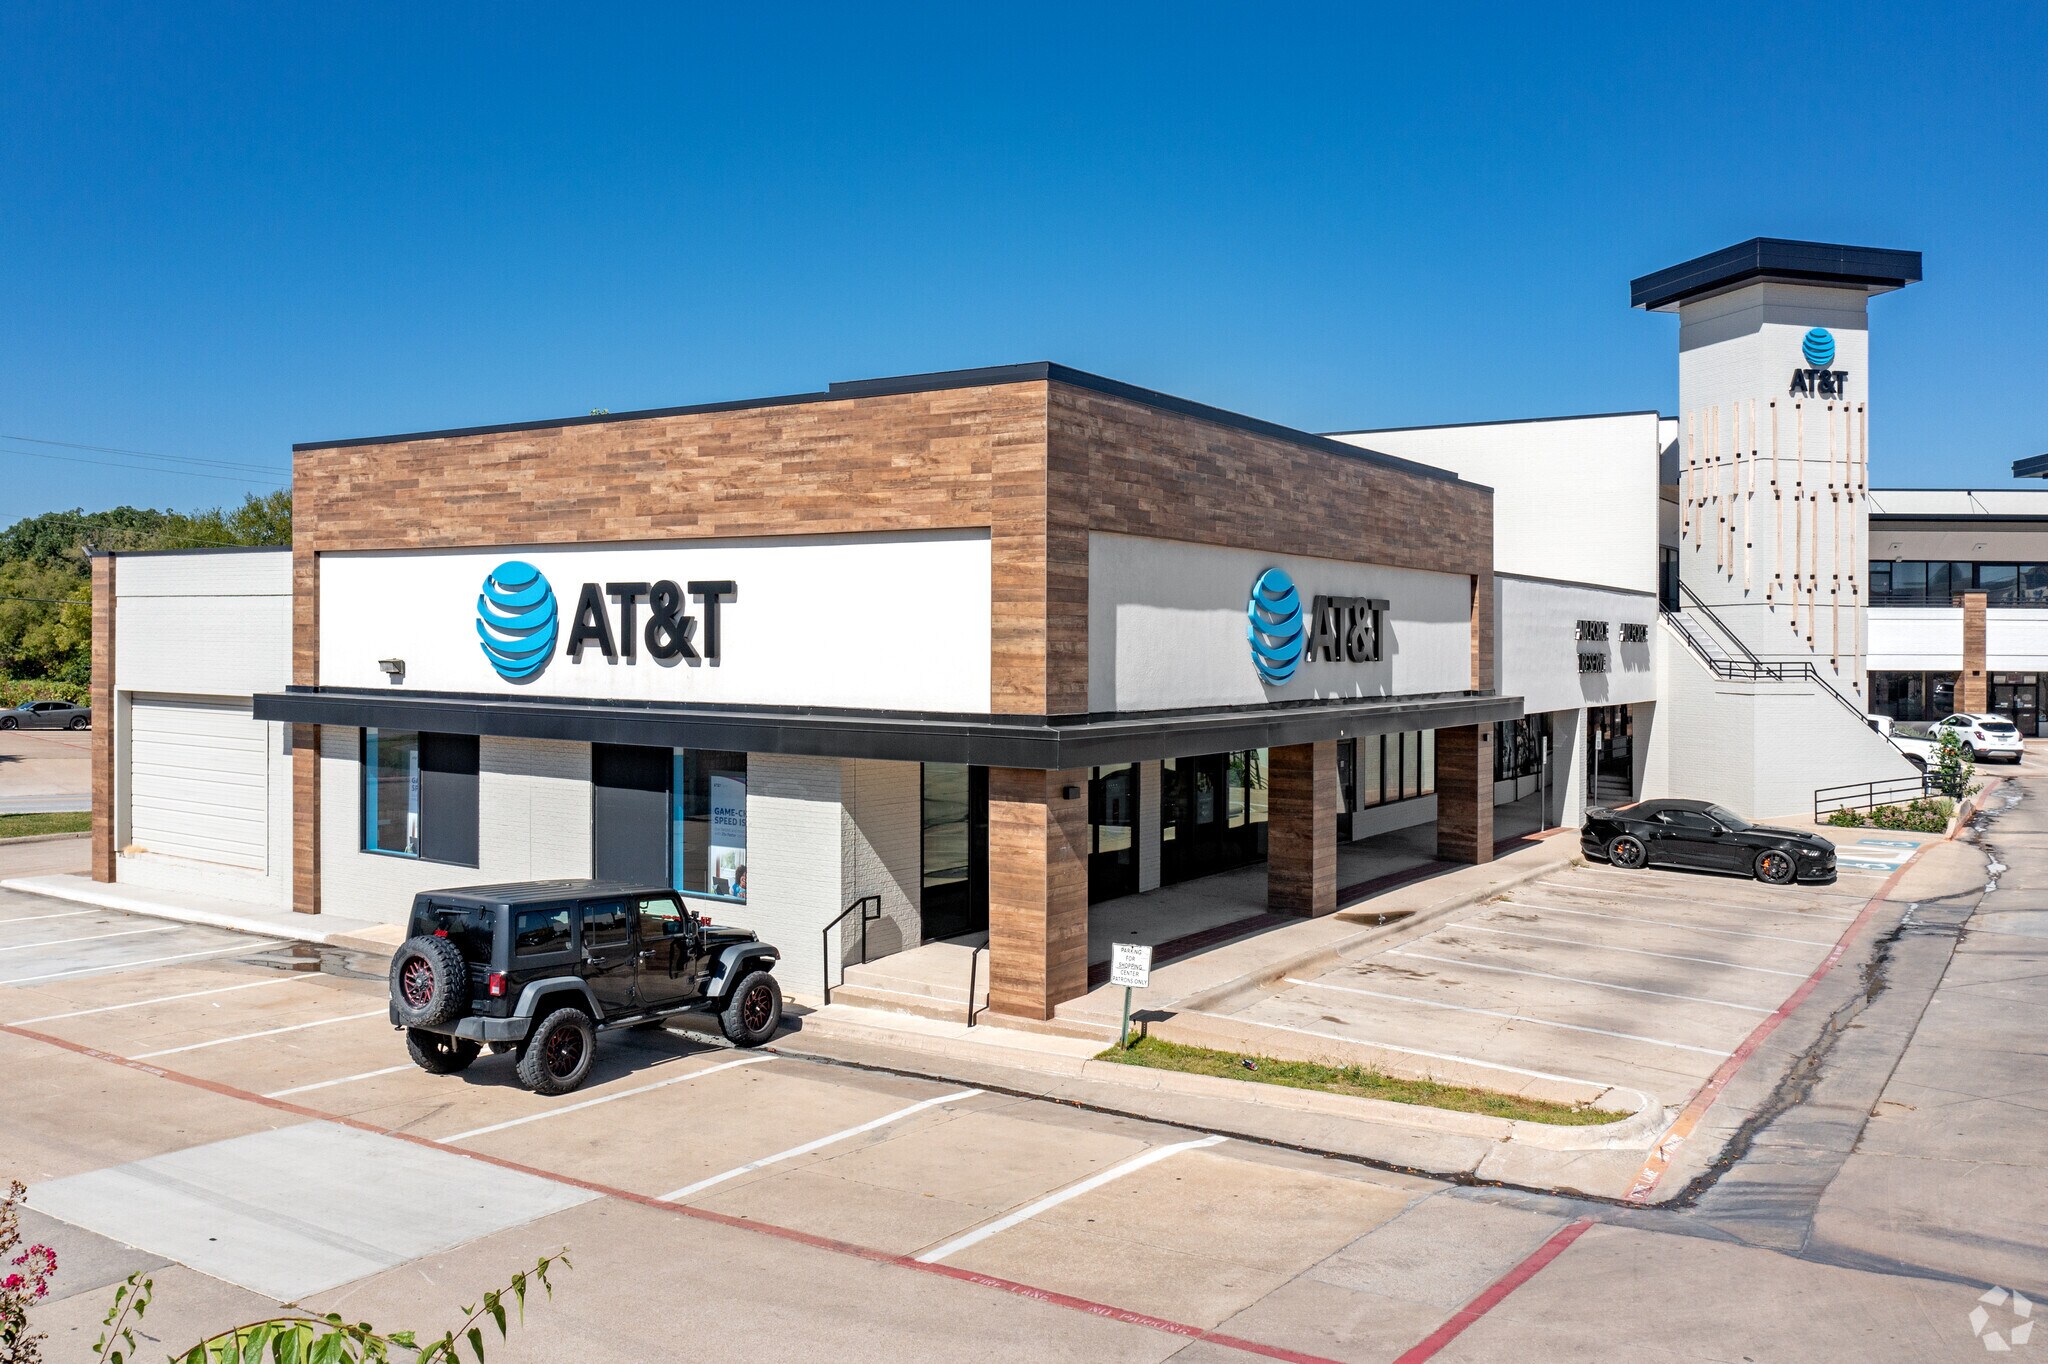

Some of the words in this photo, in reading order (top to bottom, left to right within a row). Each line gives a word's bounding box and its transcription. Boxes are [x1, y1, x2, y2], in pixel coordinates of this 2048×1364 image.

[1789, 368, 1849, 394] AT&T
[566, 580, 737, 660] AT&T
[1306, 595, 1391, 663] AT&T
[714, 816, 738, 826] SPEED
[739, 819, 746, 827] IS
[1121, 947, 1142, 956] PARKING
[1118, 962, 1143, 971] SHOPPING
[1120, 969, 1140, 977] CENTER
[1112, 975, 1134, 984] PATRONS
